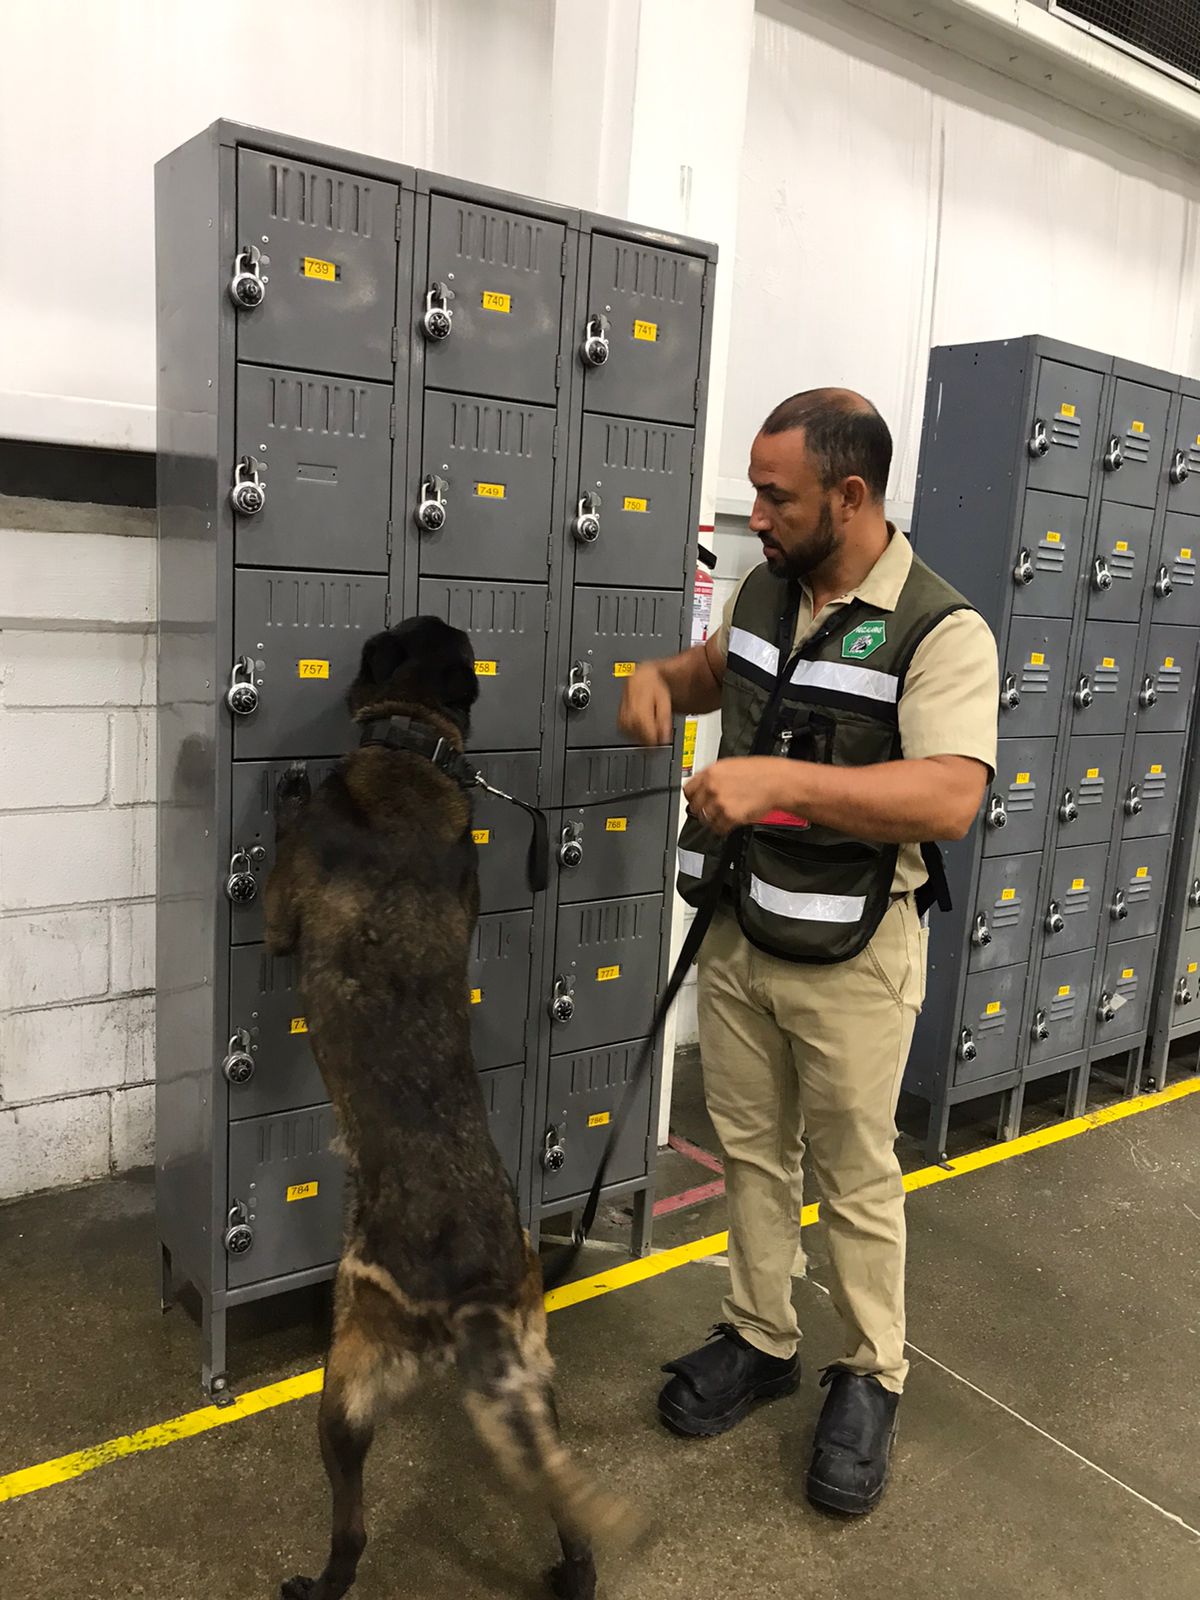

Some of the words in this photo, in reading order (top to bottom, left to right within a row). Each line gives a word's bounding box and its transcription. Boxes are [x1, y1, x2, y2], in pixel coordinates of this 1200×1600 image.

[307, 261, 329, 275] 739
[487, 294, 504, 307] 740
[637, 324, 652, 336] 741
[480, 487, 499, 496] 749
[626, 501, 641, 510] 750
[302, 664, 323, 675] 757
[474, 663, 490, 673] 758
[617, 663, 632, 673] 759
[607, 821, 621, 829] 768
[473, 833, 486, 841] 67
[600, 968, 615, 978] 777
[294, 1019, 305, 1030] 77
[291, 1184, 310, 1196] 784
